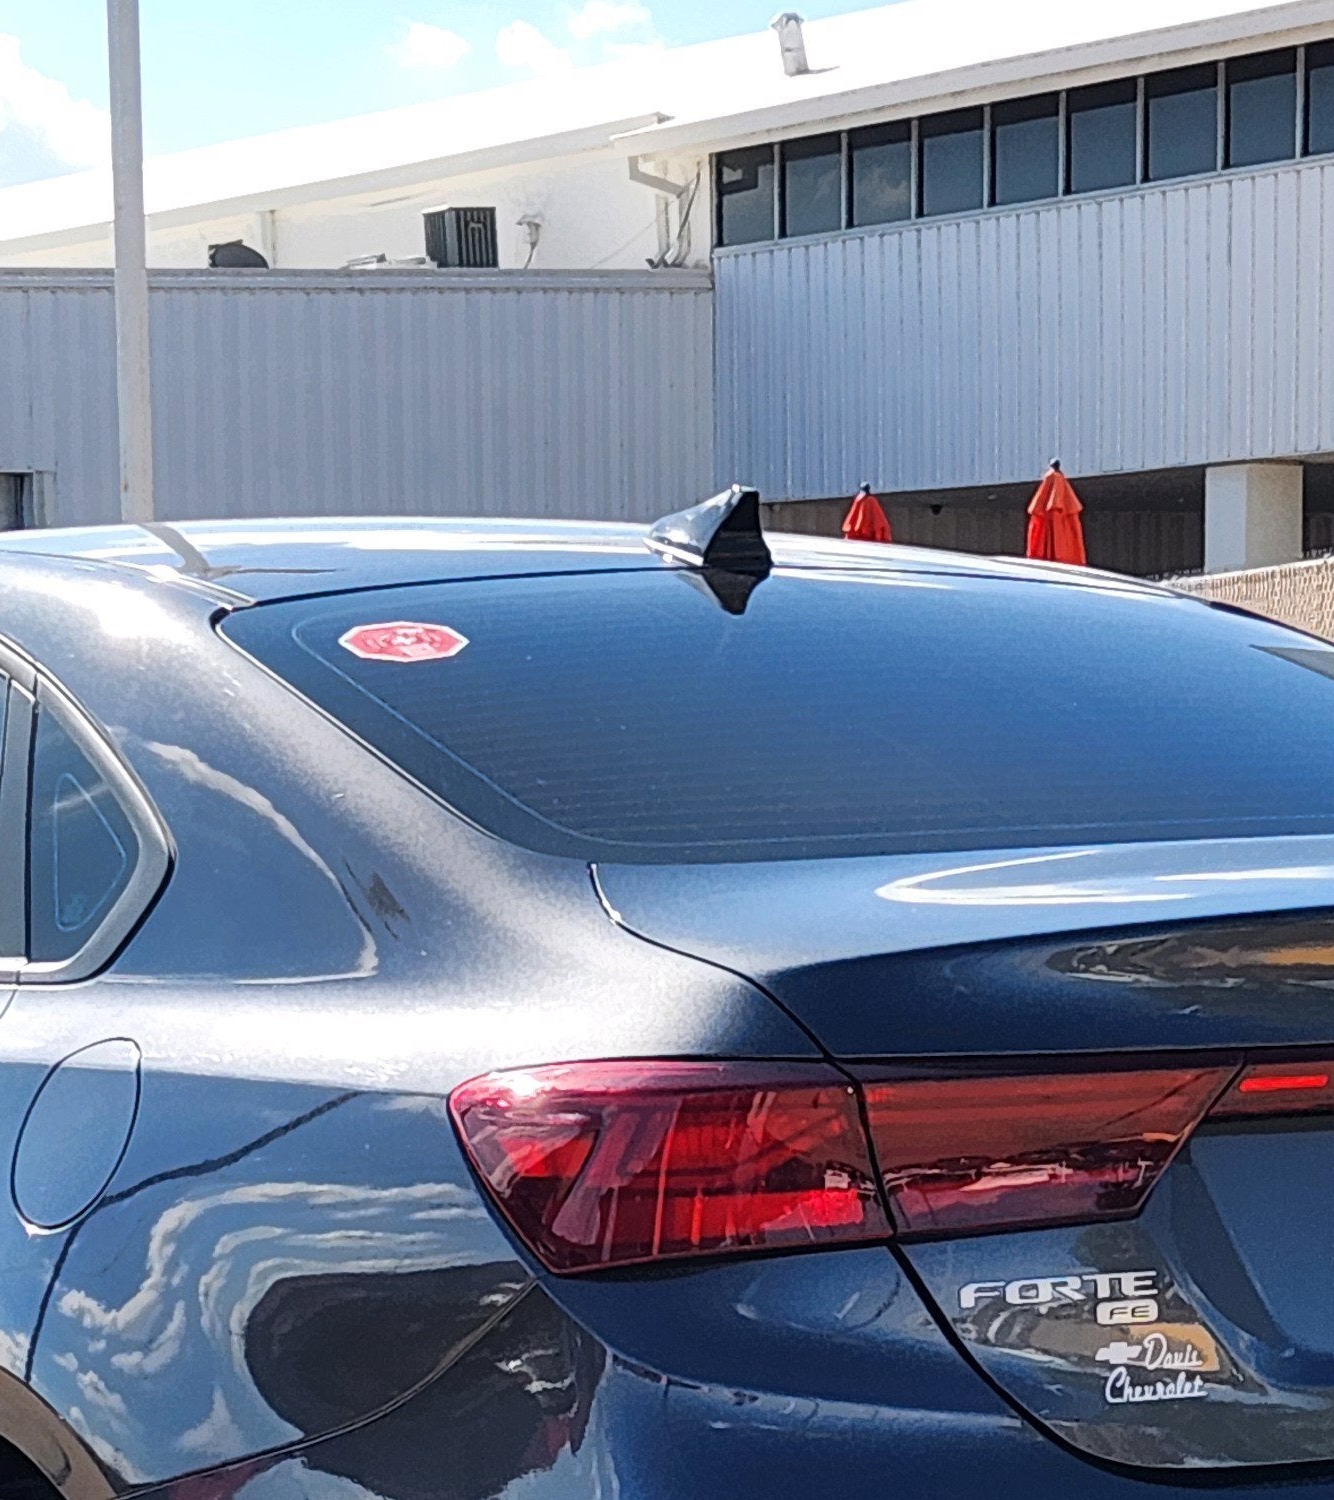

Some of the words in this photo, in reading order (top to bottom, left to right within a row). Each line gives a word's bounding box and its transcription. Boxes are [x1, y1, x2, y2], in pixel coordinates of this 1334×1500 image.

[960, 1271, 1158, 1308] FORTE
[1109, 1305, 1151, 1319] FE
[1105, 1367, 1208, 1404] Chevrolet
